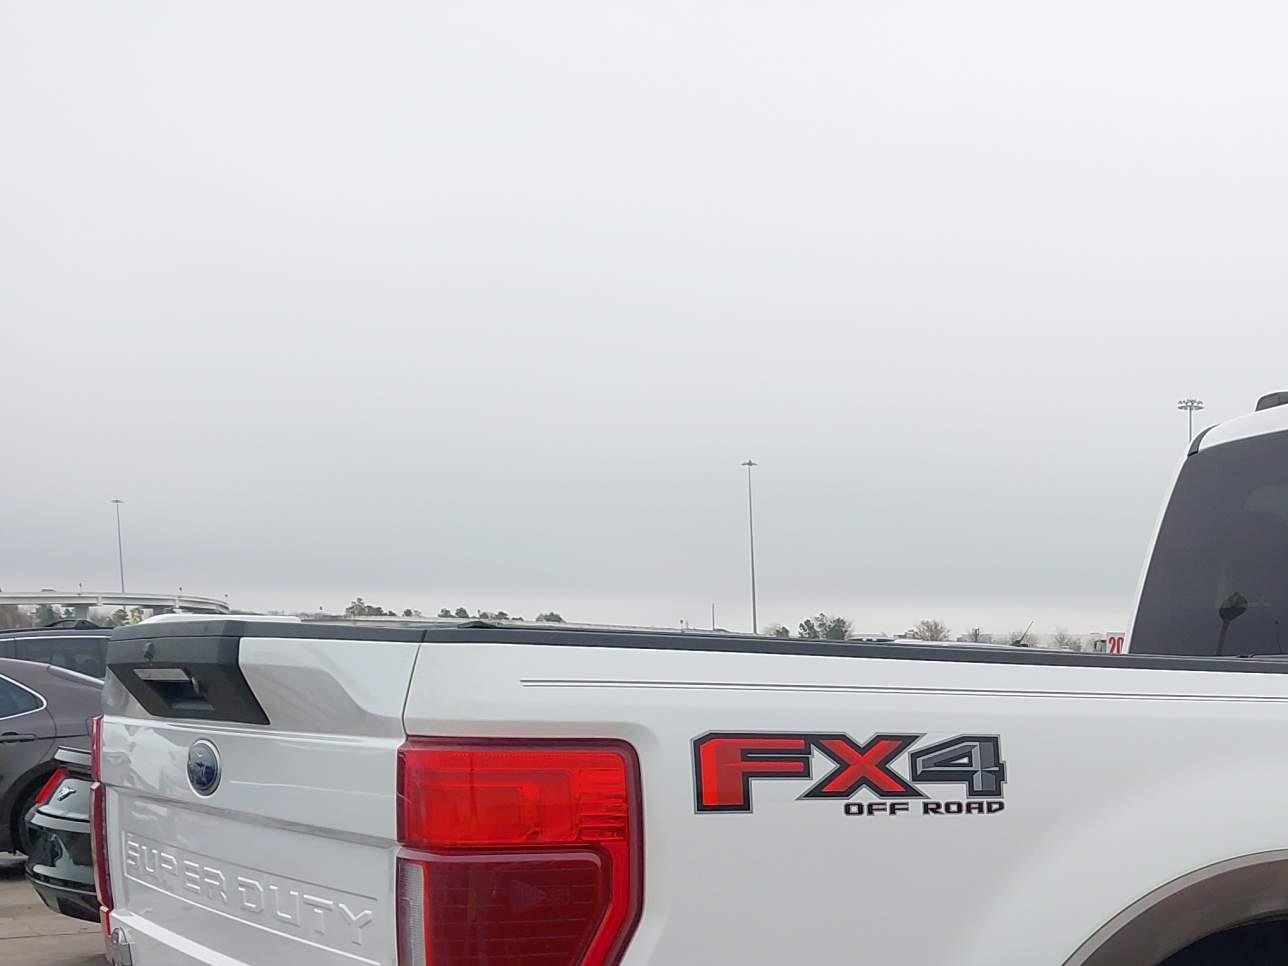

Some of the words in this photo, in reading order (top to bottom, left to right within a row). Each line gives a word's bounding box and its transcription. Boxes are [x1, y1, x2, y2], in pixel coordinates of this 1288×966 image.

[690, 730, 1007, 814] FX4
[844, 801, 910, 816] OFF
[922, 801, 1005, 815] ROAD
[127, 838, 229, 904] SUPER
[237, 875, 374, 946] DUTY
